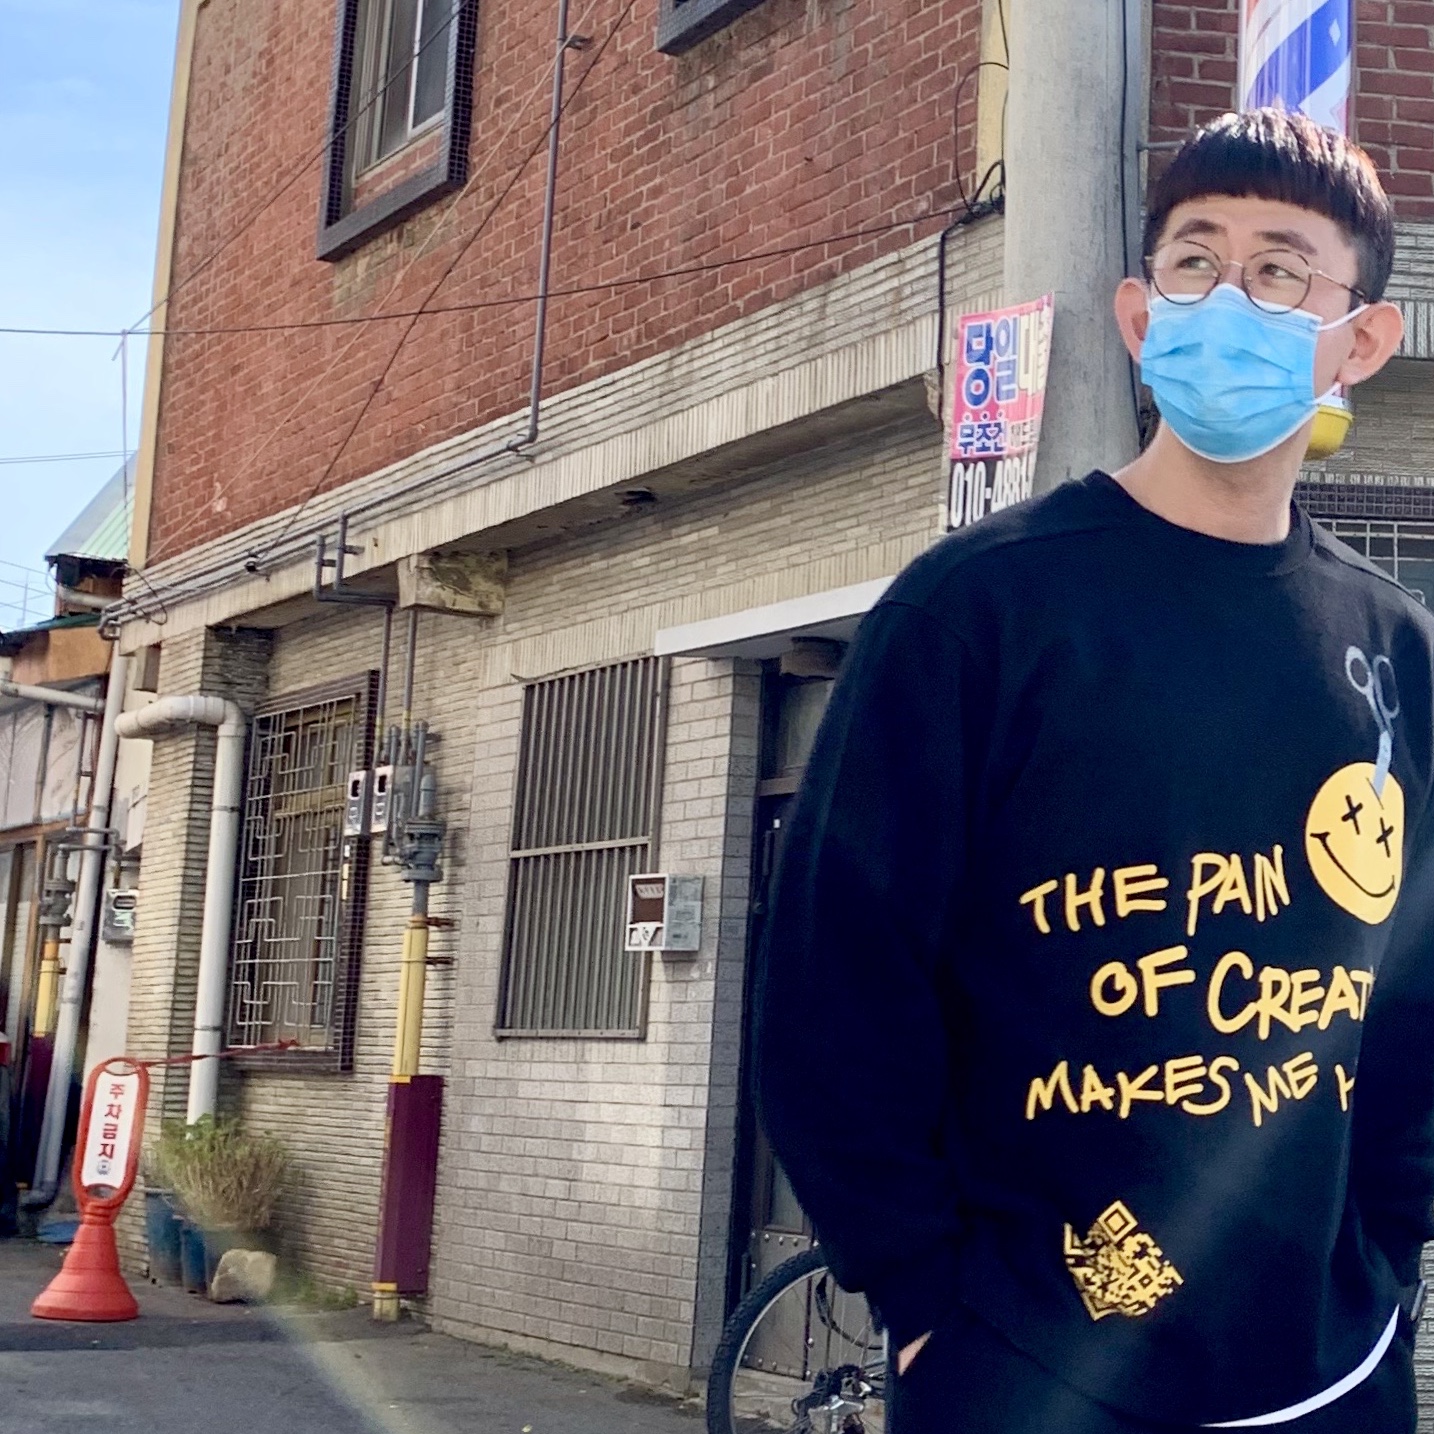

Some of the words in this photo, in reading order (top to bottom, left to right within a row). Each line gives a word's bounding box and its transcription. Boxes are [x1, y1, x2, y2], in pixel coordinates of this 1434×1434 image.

[958, 420, 1006, 455] 무조건
[1019, 863, 1169, 934] THE
[1187, 844, 1291, 936] PAIN
[1090, 944, 1196, 1017] OF
[98, 1083, 125, 1159] 주차금지
[1025, 1054, 1239, 1121] MAKES
[1244, 1051, 1319, 1127] ME
